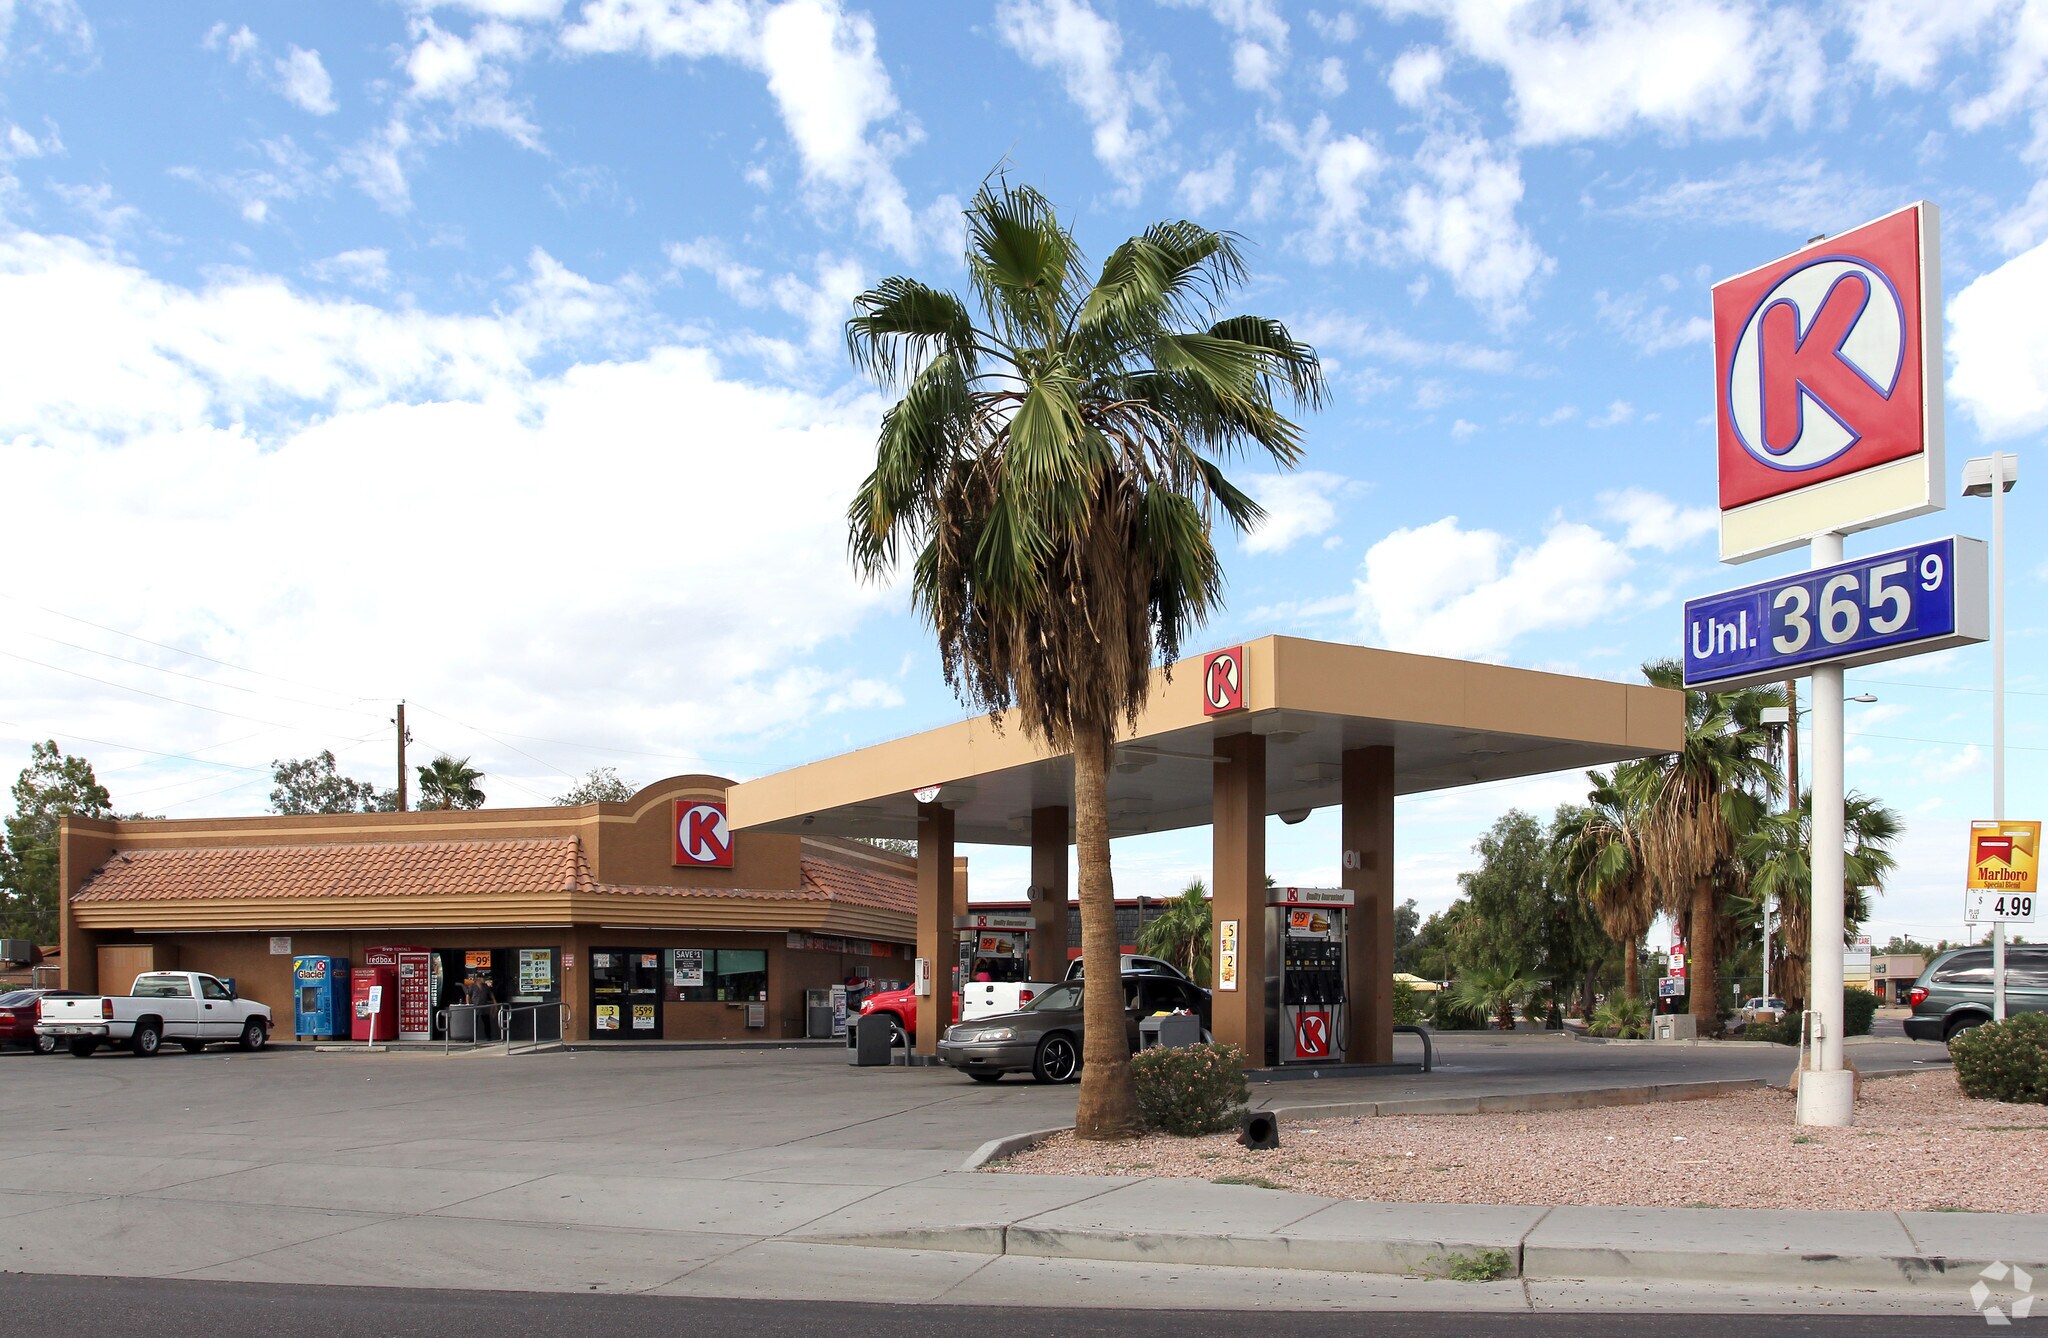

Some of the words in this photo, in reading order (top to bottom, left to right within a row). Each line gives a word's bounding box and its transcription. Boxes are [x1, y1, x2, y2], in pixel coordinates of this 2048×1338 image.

[1757, 270, 1890, 457] K
[1692, 610, 1757, 660] Unl.
[1346, 853, 1352, 865] 4
[1978, 868, 2028, 881] Marlboro
[1983, 881, 2005, 889] Special
[1978, 896, 1983, 905] $
[1994, 897, 2032, 916] 4.99
[1859, 937, 1870, 945] CARE
[676, 950, 693, 959] SAVE
[298, 970, 325, 979] Glacier
